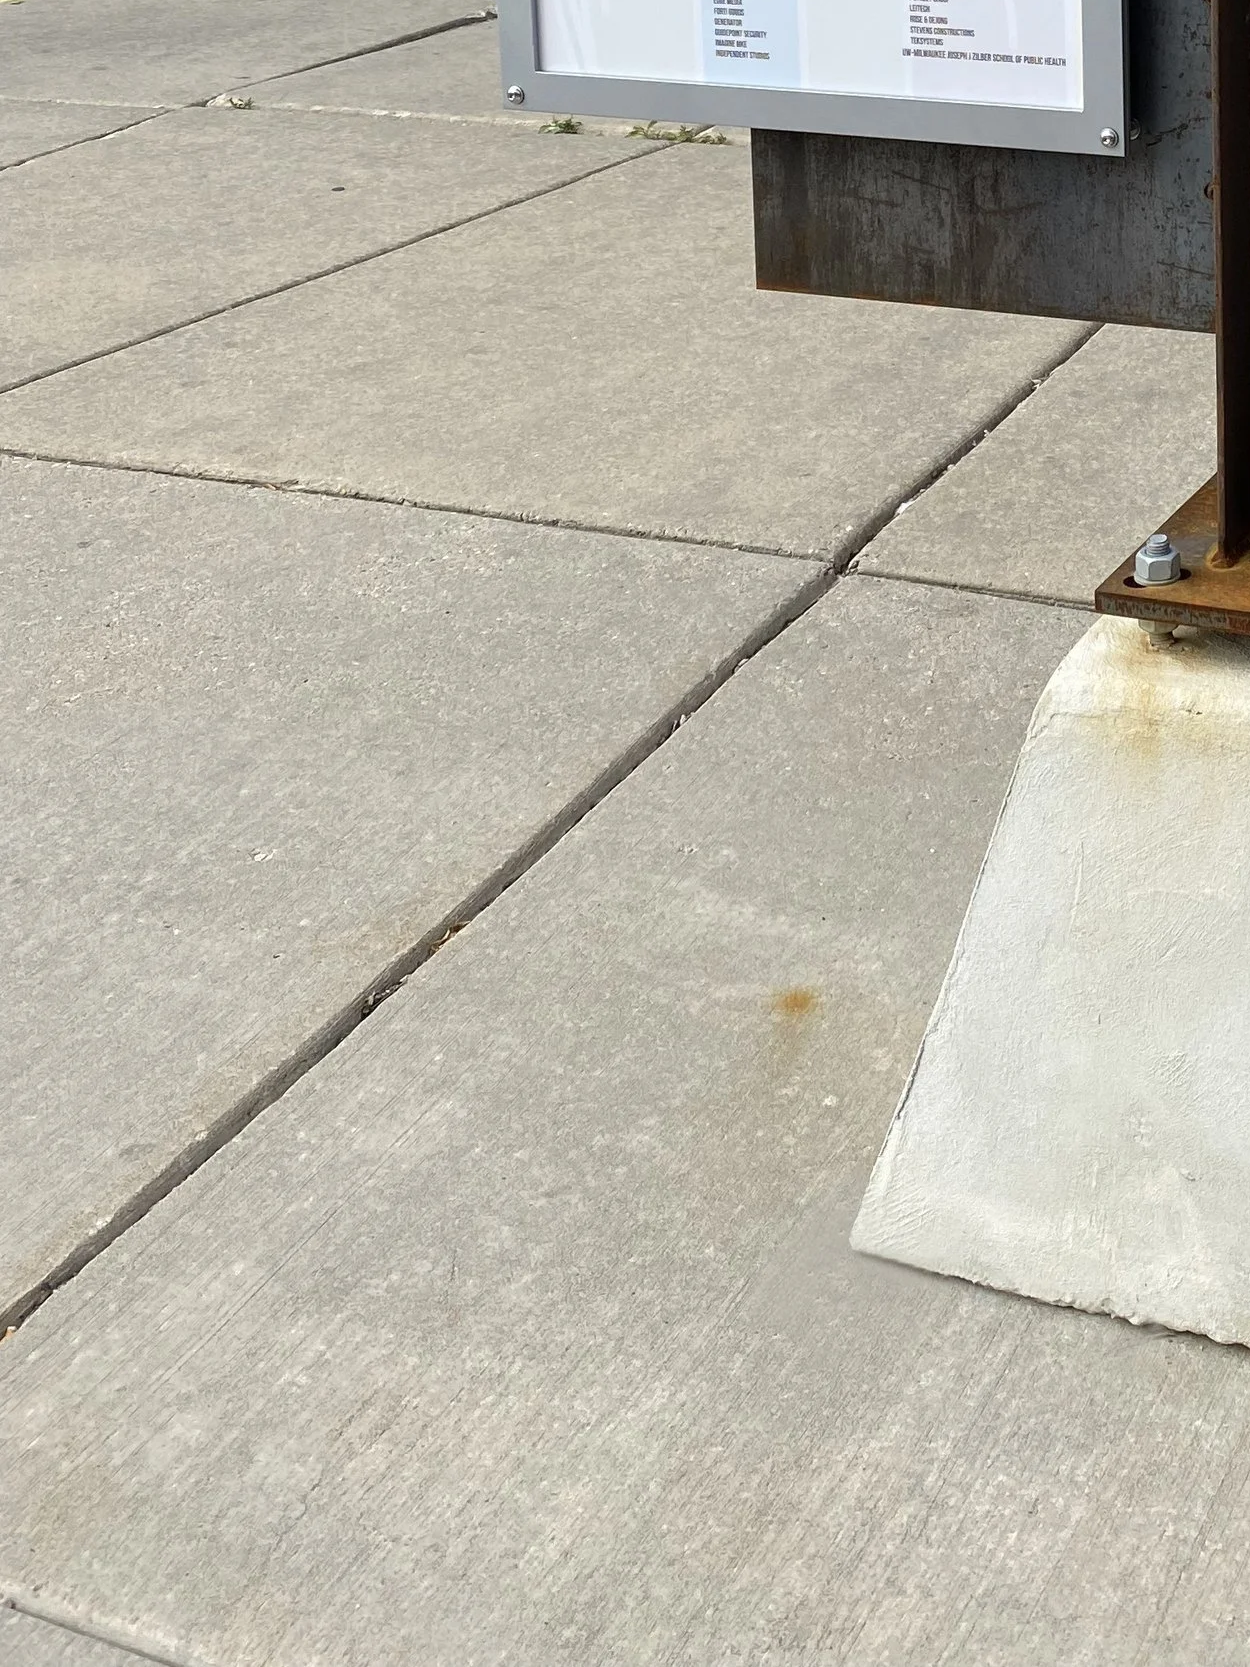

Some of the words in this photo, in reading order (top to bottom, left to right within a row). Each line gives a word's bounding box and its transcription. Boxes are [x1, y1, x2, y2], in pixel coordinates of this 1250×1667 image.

[902, 49, 946, 58] UW-MILWAUKEE
[947, 51, 967, 59] JOSEPH
[972, 53, 991, 61] ZILBER
[1024, 56, 1043, 65] PUBLIC
[1045, 57, 1066, 66] HEALTH
